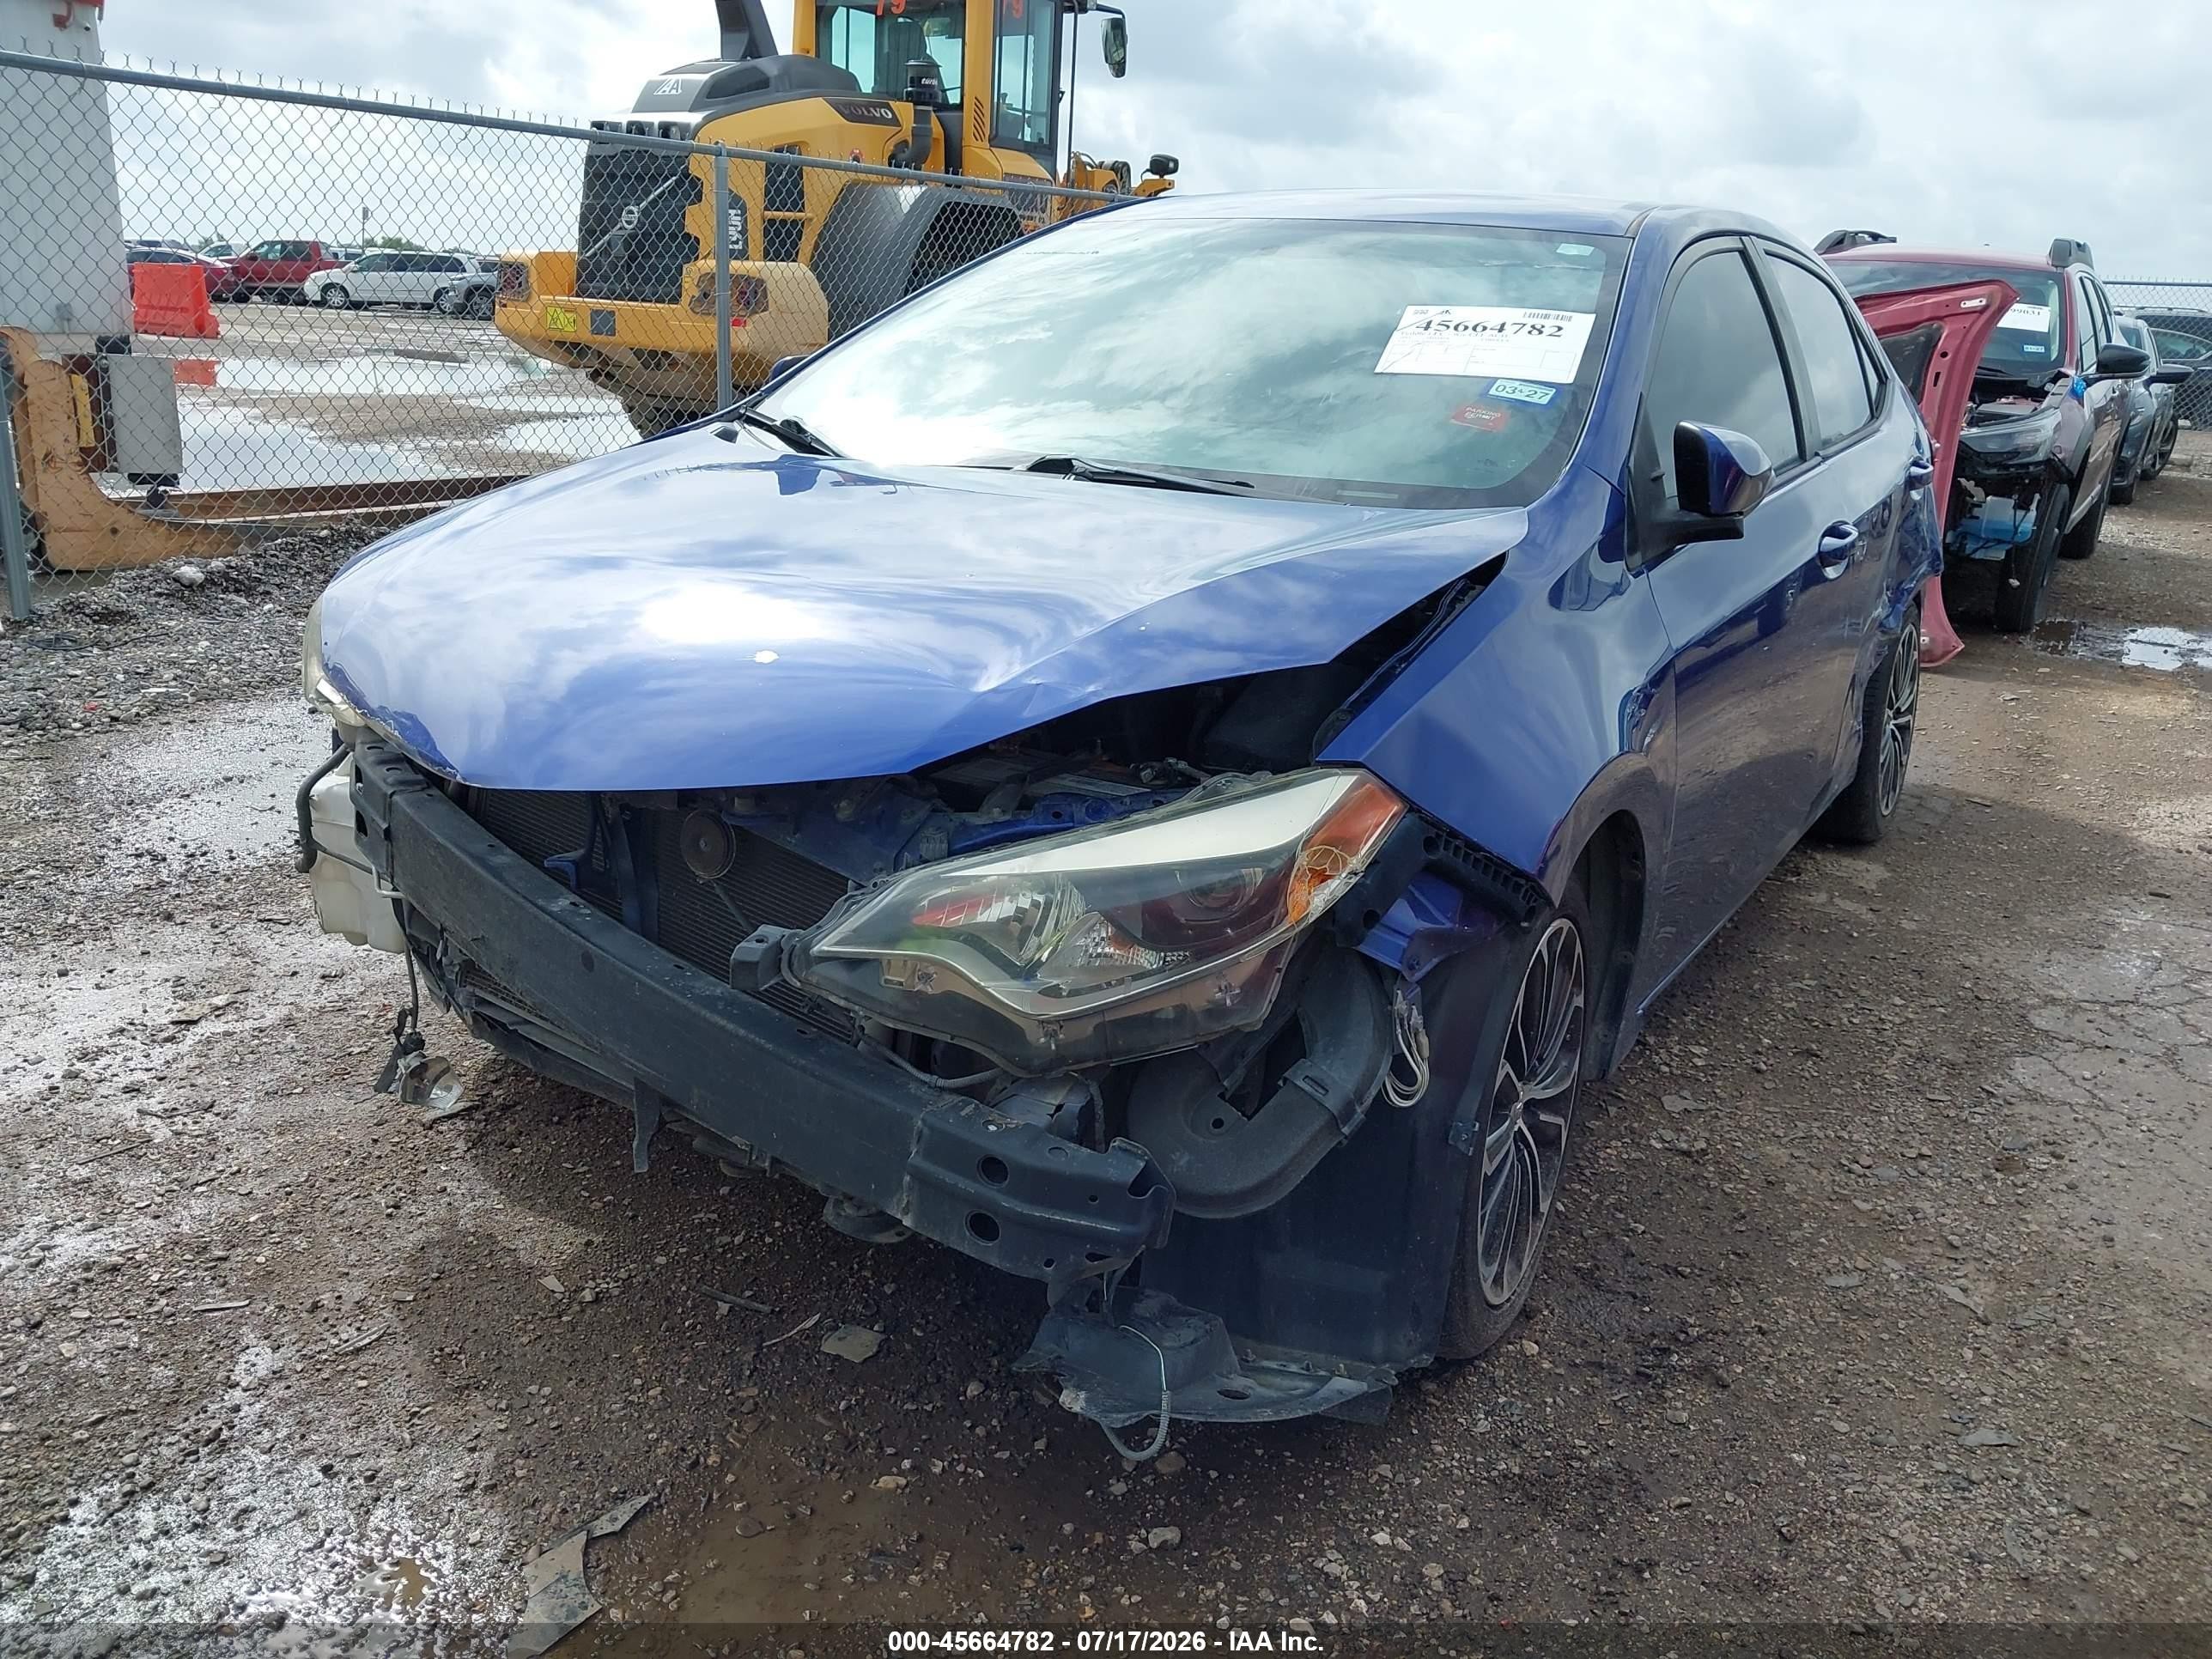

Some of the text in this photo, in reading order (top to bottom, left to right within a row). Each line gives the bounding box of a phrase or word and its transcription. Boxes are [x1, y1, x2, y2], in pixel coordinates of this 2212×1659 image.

[840, 104, 893, 118] VOLVO
[1415, 319, 1564, 337] 45664782
[1495, 385, 1550, 400] 03 27
